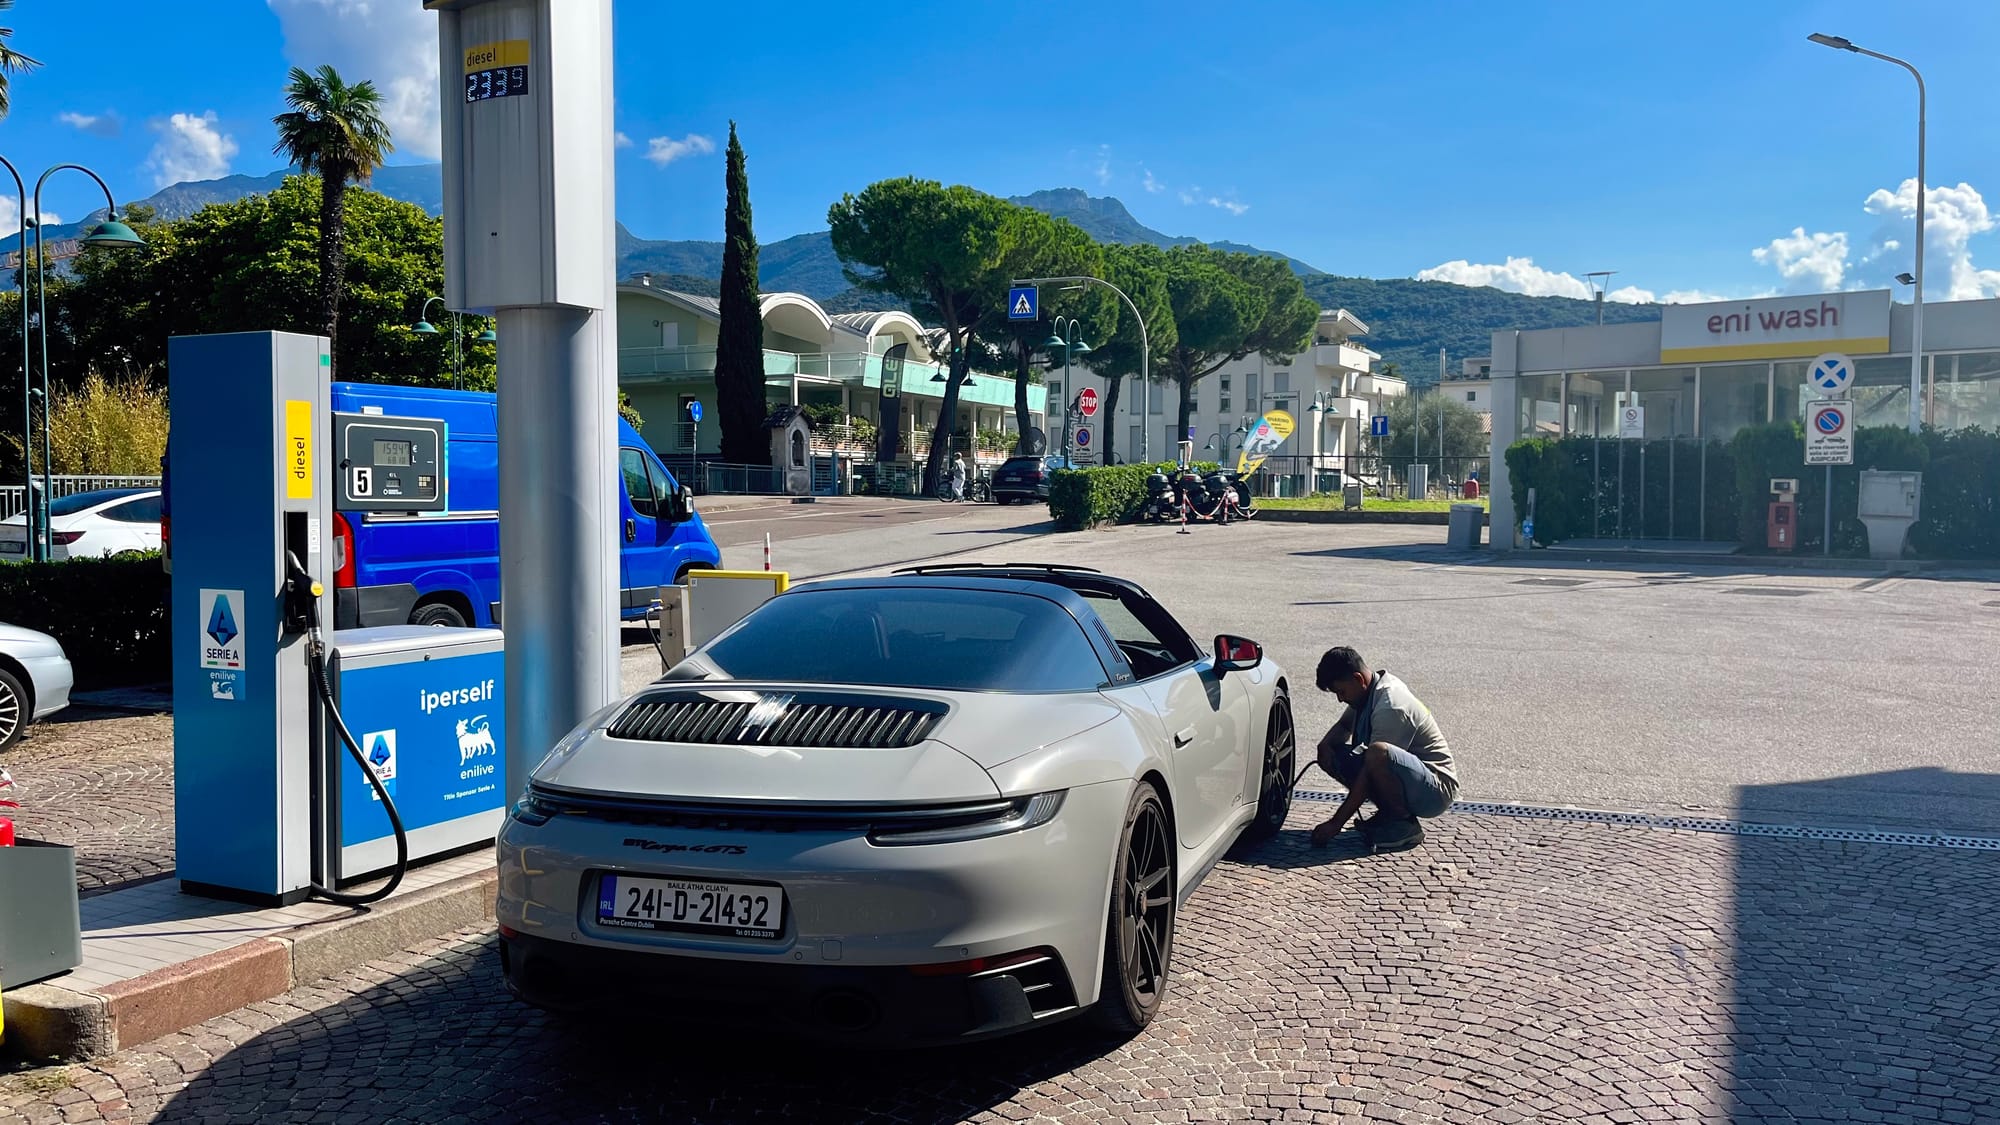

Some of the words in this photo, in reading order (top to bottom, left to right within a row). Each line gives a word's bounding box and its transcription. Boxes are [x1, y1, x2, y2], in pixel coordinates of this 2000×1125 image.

[467, 48, 496, 67] diesel
[1707, 306, 1750, 334] eni
[1758, 300, 1839, 330] wash
[1081, 397, 1097, 408] STOP
[293, 437, 306, 479] diesel
[357, 470, 369, 494] 5
[207, 648, 231, 660] SERIE
[233, 650, 239, 660] A
[210, 671, 236, 681] enilive
[421, 679, 495, 714] iperself
[460, 764, 494, 780] enilive
[456, 788, 477, 798] Sponsor
[477, 785, 490, 793] Serie
[704, 845, 748, 855] GTS
[667, 882, 686, 890] BAILE
[705, 884, 729, 892] CLIATH
[600, 900, 613, 911] IRL
[626, 887, 769, 928] 241-D-21432
[600, 917, 620, 926] Porsche
[620, 919, 637, 927] Centre
[638, 920, 655, 929] Dublin
